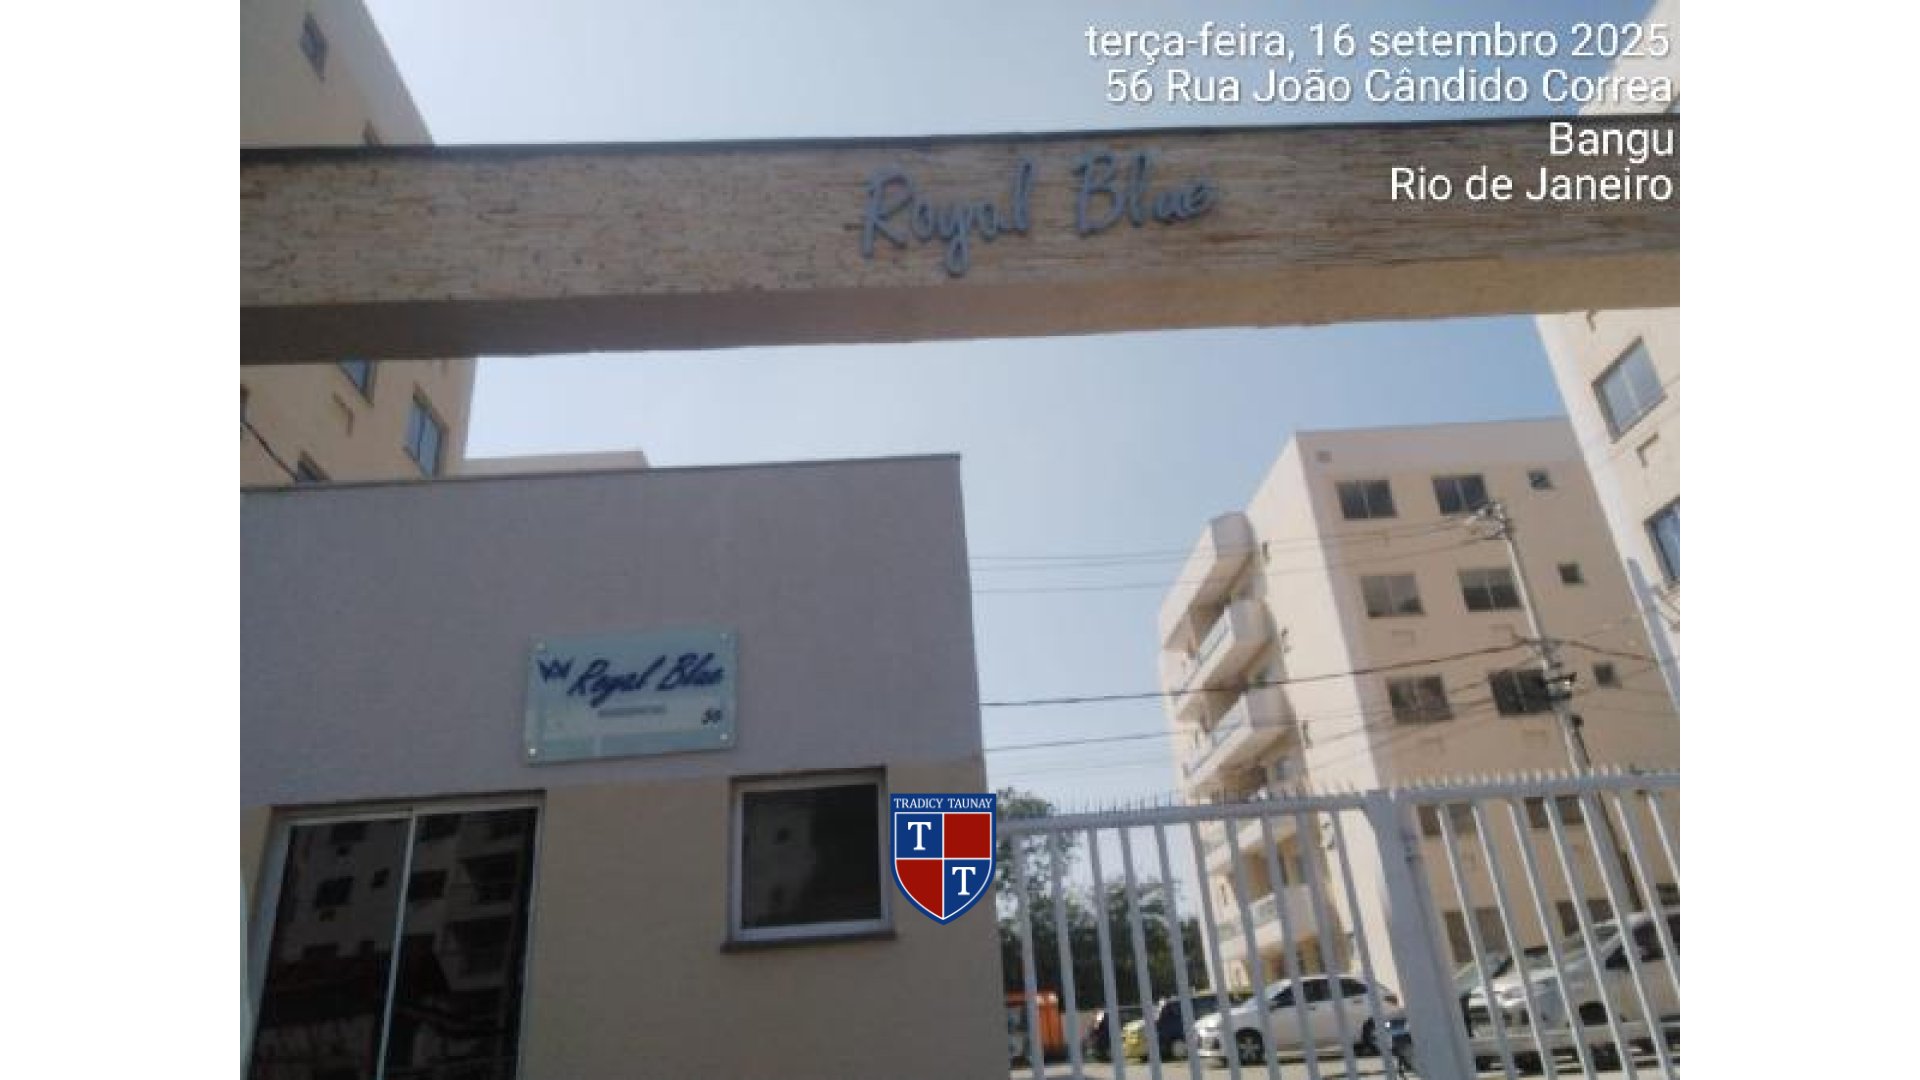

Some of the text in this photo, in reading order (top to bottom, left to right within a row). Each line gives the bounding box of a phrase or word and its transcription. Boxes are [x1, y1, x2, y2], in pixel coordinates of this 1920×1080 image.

[861, 148, 1217, 278] Royal Blue
[566, 652, 725, 708] Royal Blue
